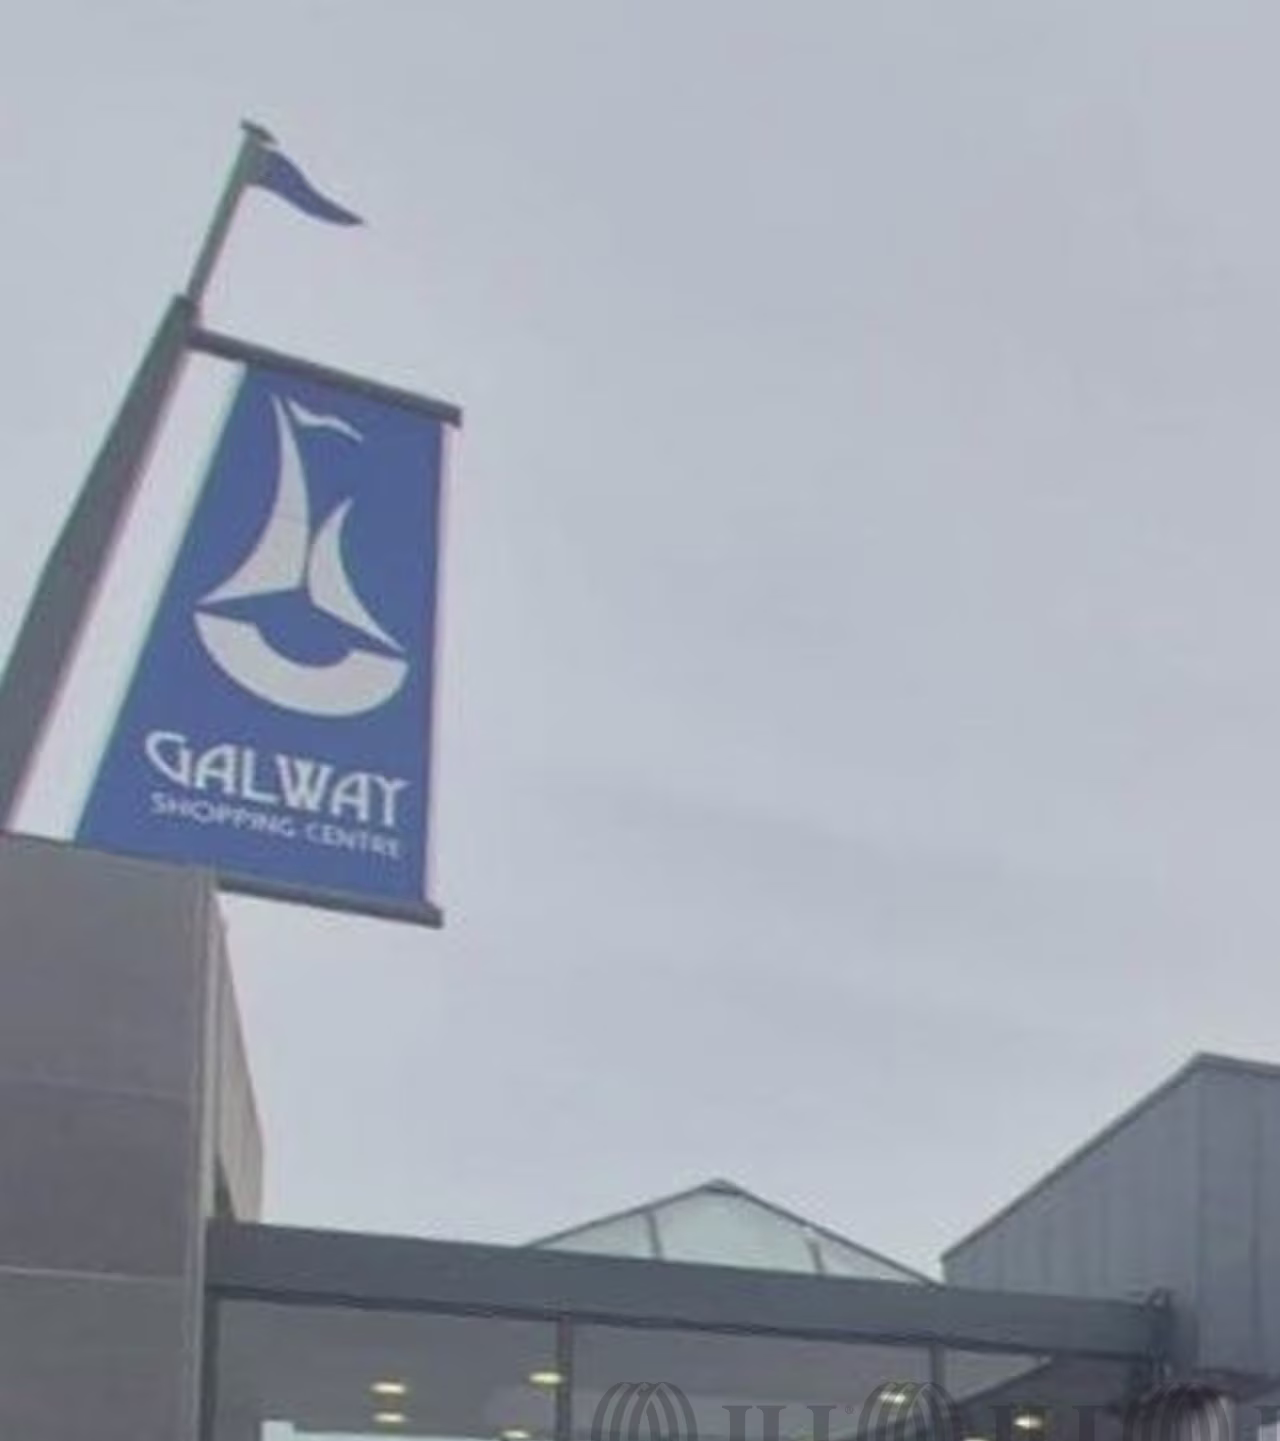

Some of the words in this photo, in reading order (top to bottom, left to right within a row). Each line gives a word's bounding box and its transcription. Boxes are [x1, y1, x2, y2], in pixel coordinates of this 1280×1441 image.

[144, 730, 410, 828] GALWAY
[150, 791, 297, 840] SHOPPING
[304, 820, 402, 859] CENTRE
